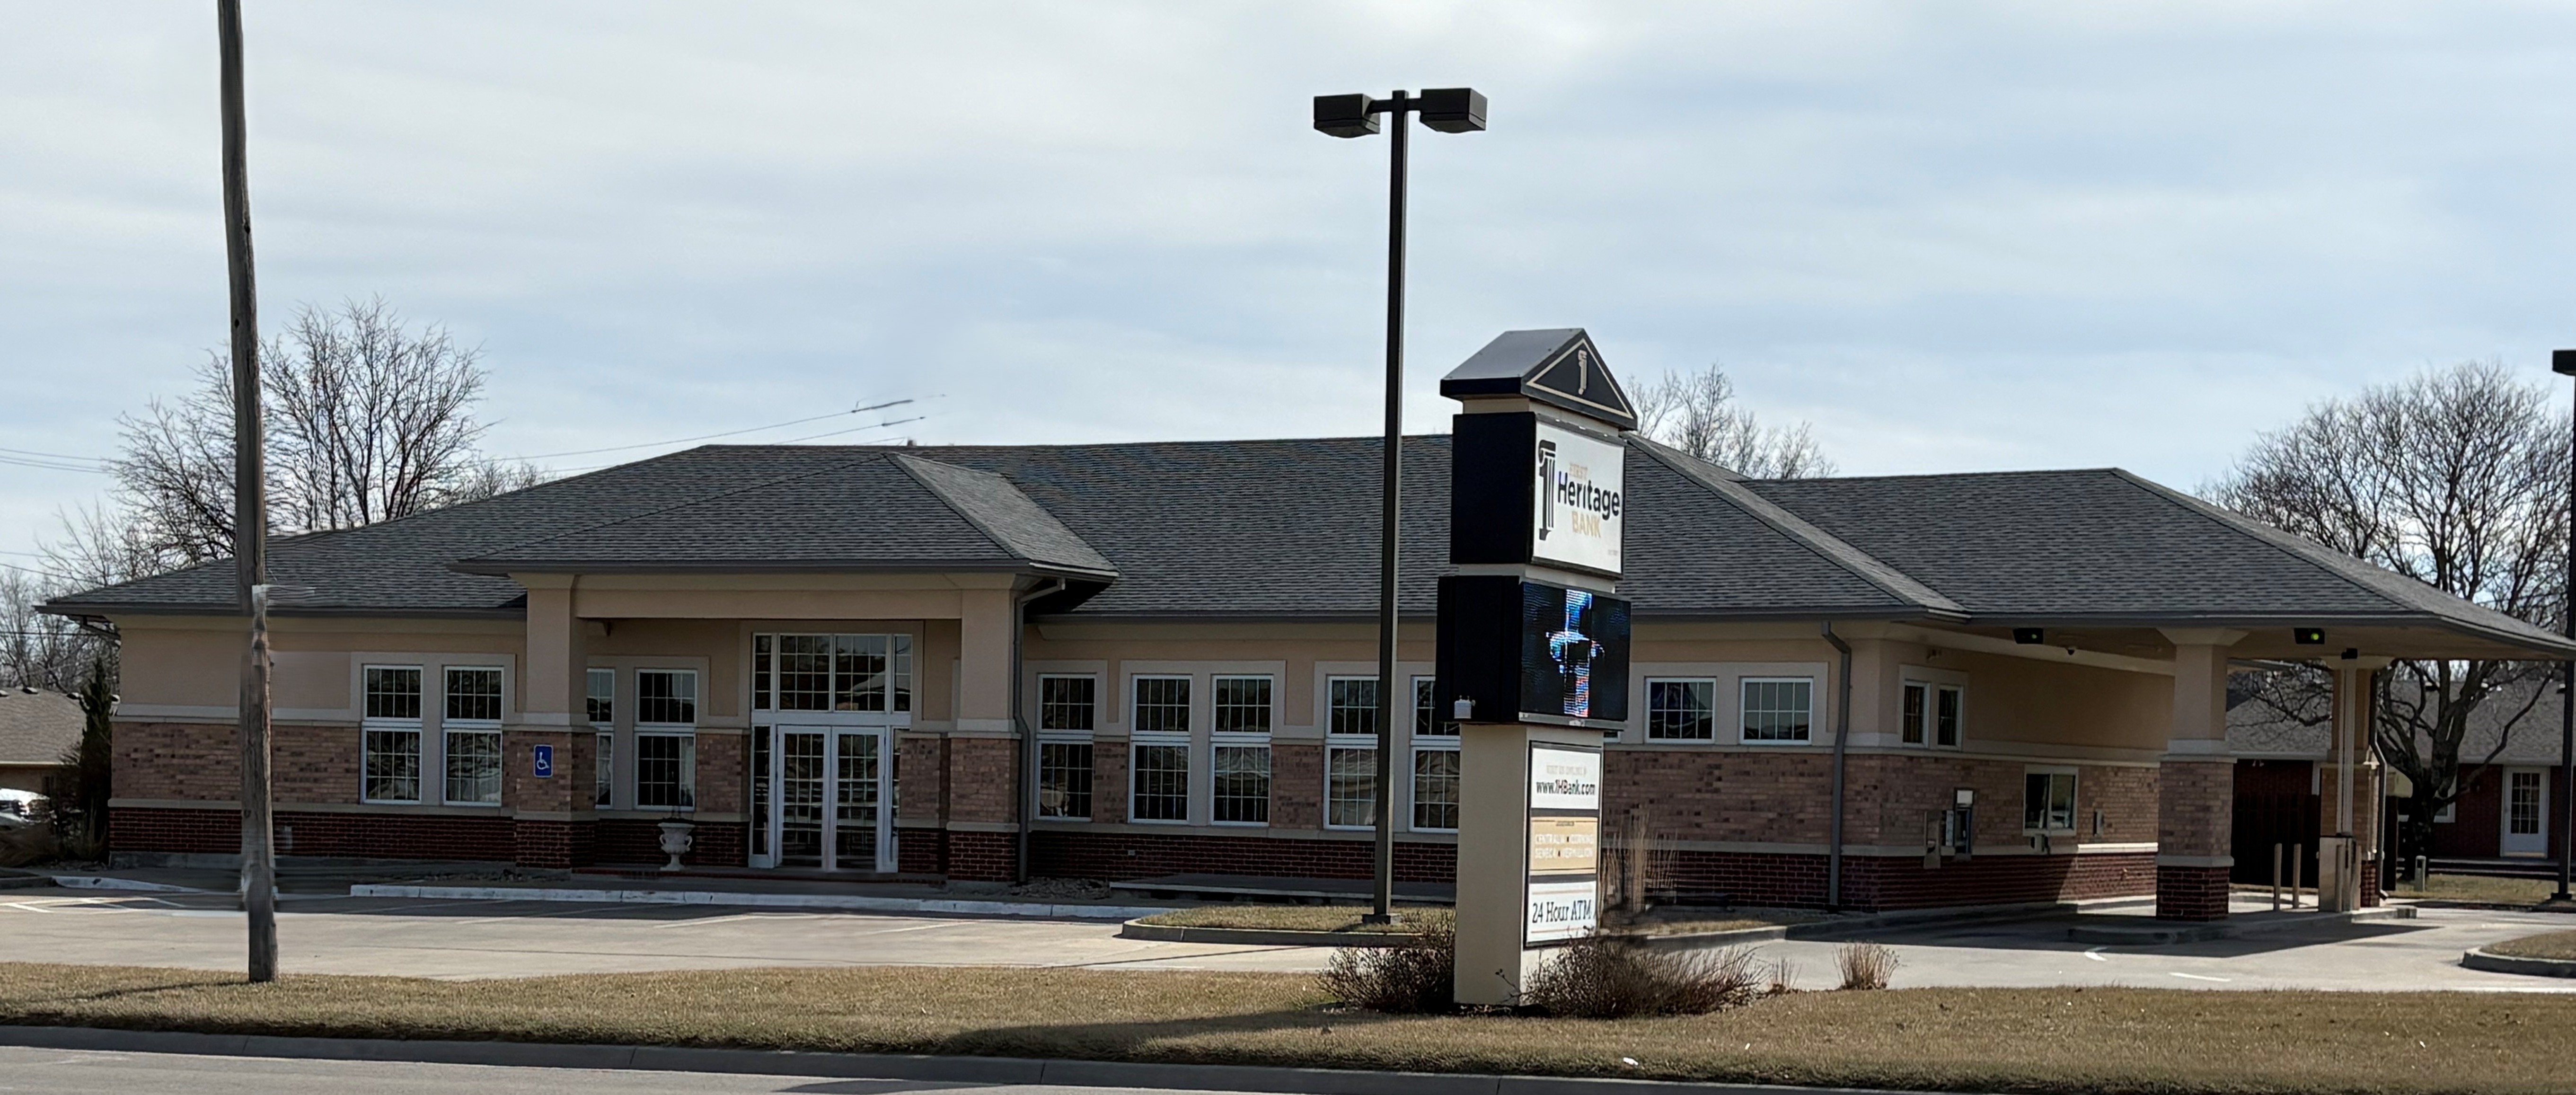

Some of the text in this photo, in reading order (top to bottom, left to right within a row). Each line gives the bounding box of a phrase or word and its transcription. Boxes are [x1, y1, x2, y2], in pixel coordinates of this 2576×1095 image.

[1558, 471, 1620, 520] Heritage
[1571, 512, 1601, 539] BANK
[1533, 900, 1591, 923] 24 Hour ATM
